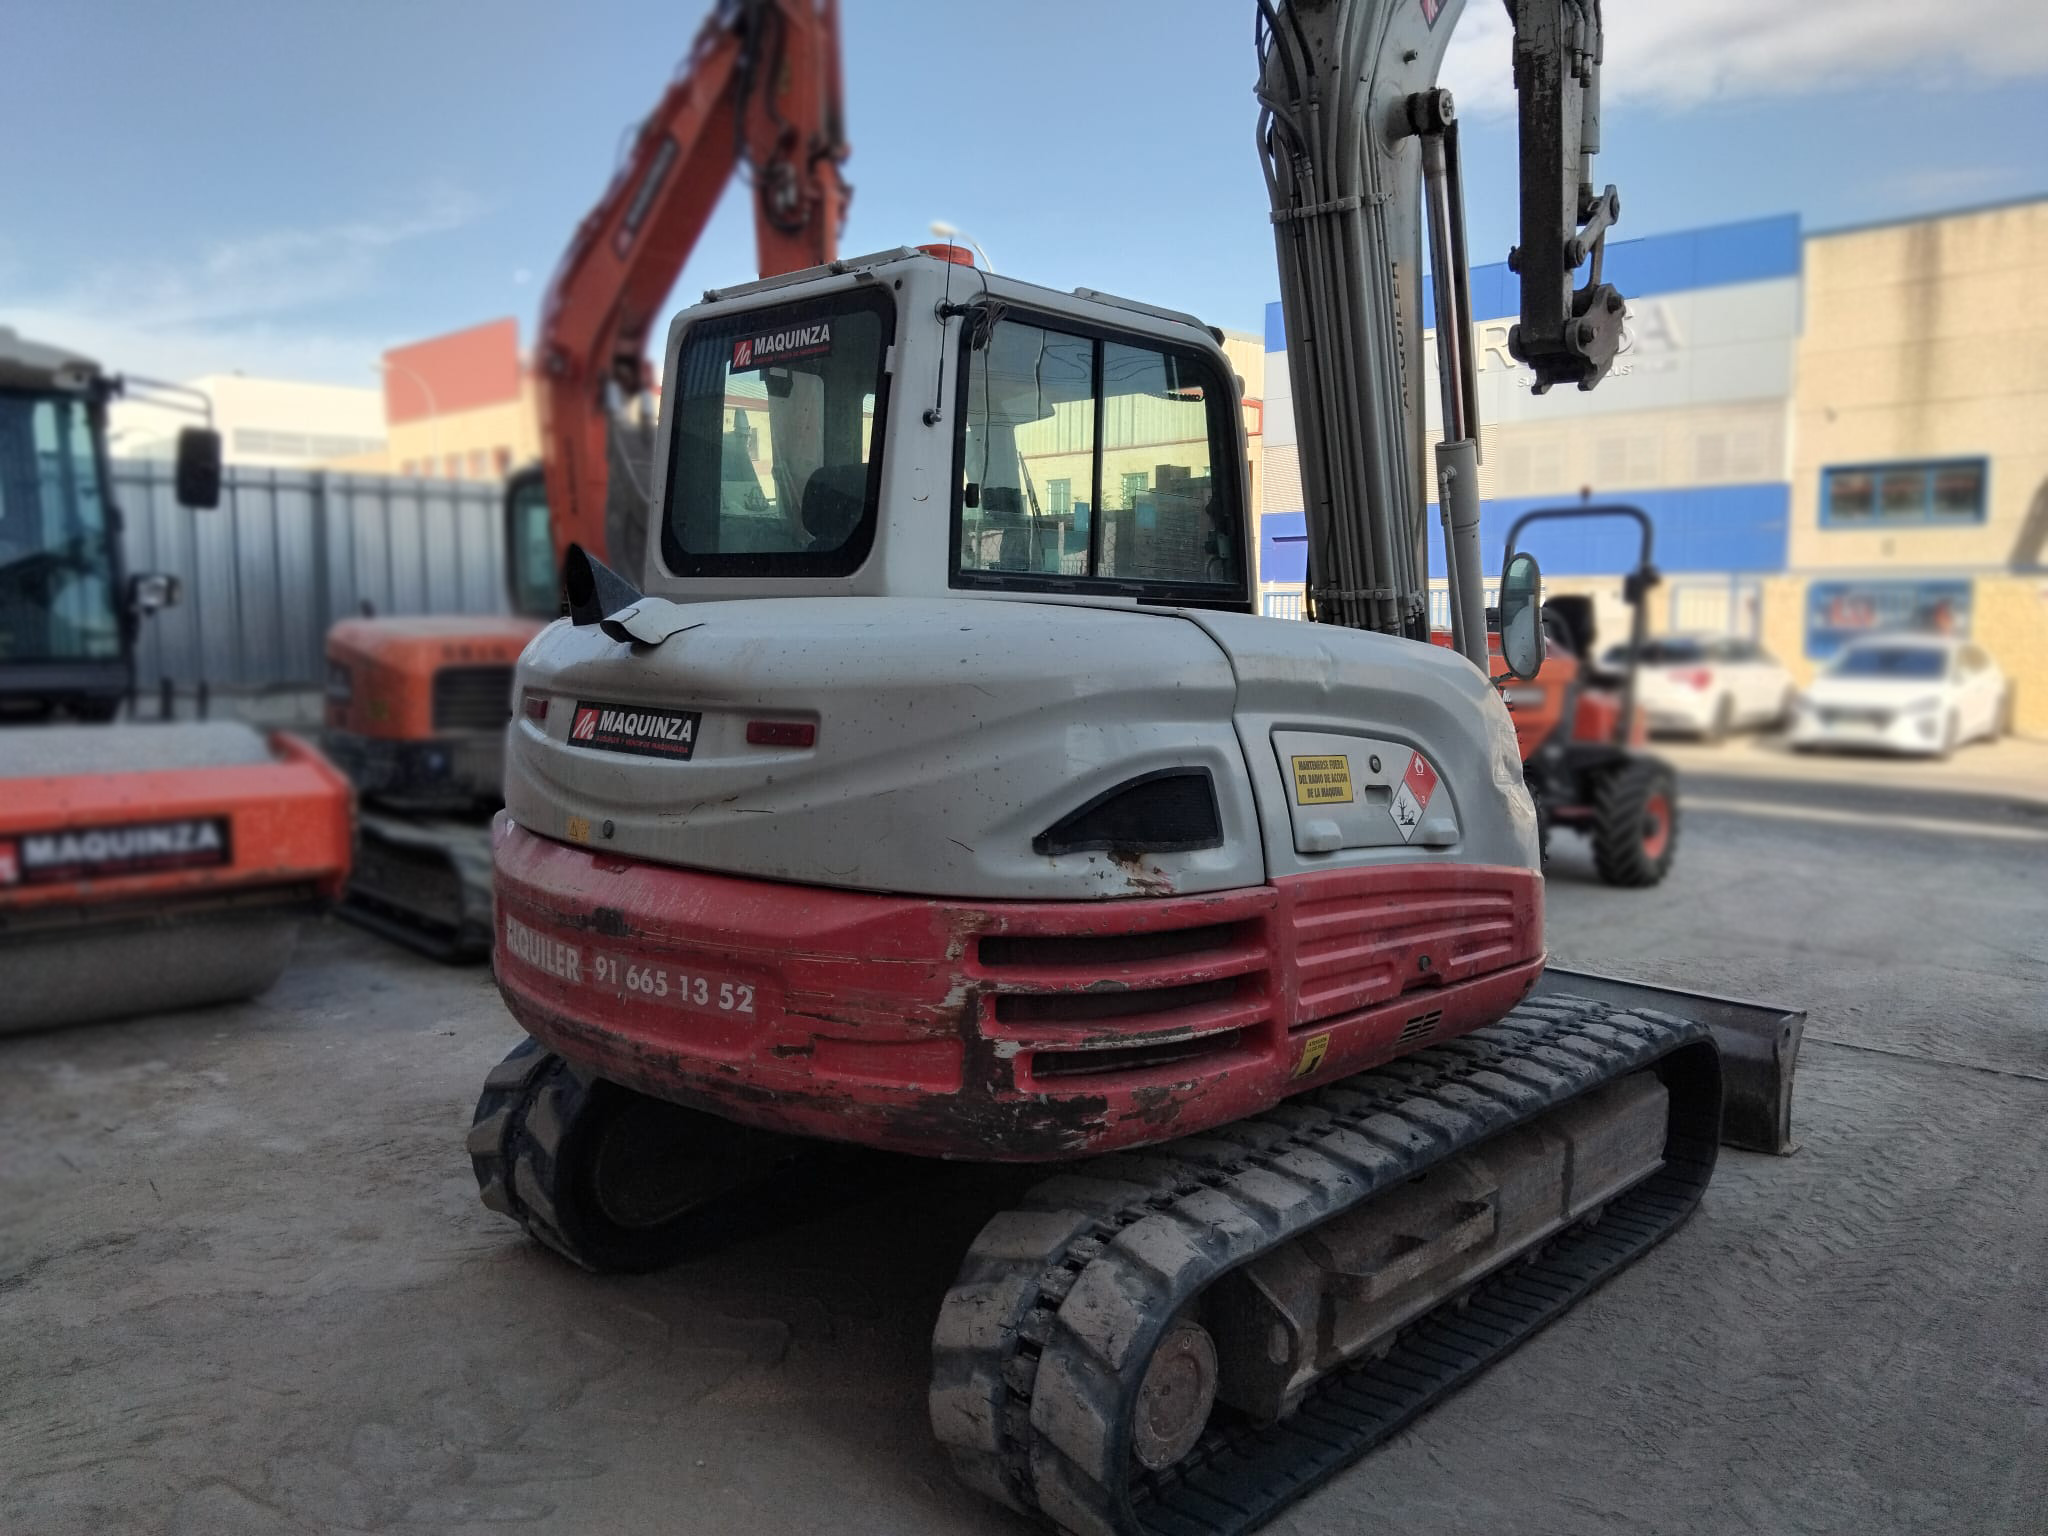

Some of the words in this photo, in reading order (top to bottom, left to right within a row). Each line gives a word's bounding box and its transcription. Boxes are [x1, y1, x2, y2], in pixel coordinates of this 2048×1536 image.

[755, 324, 830, 355] MAQUINZA
[599, 710, 692, 742] MAQUINZA
[24, 823, 220, 867] MAQUINZA
[595, 955, 617, 985] 91
[626, 965, 668, 997] 665
[680, 976, 709, 1006] 13
[718, 983, 755, 1013] 52
